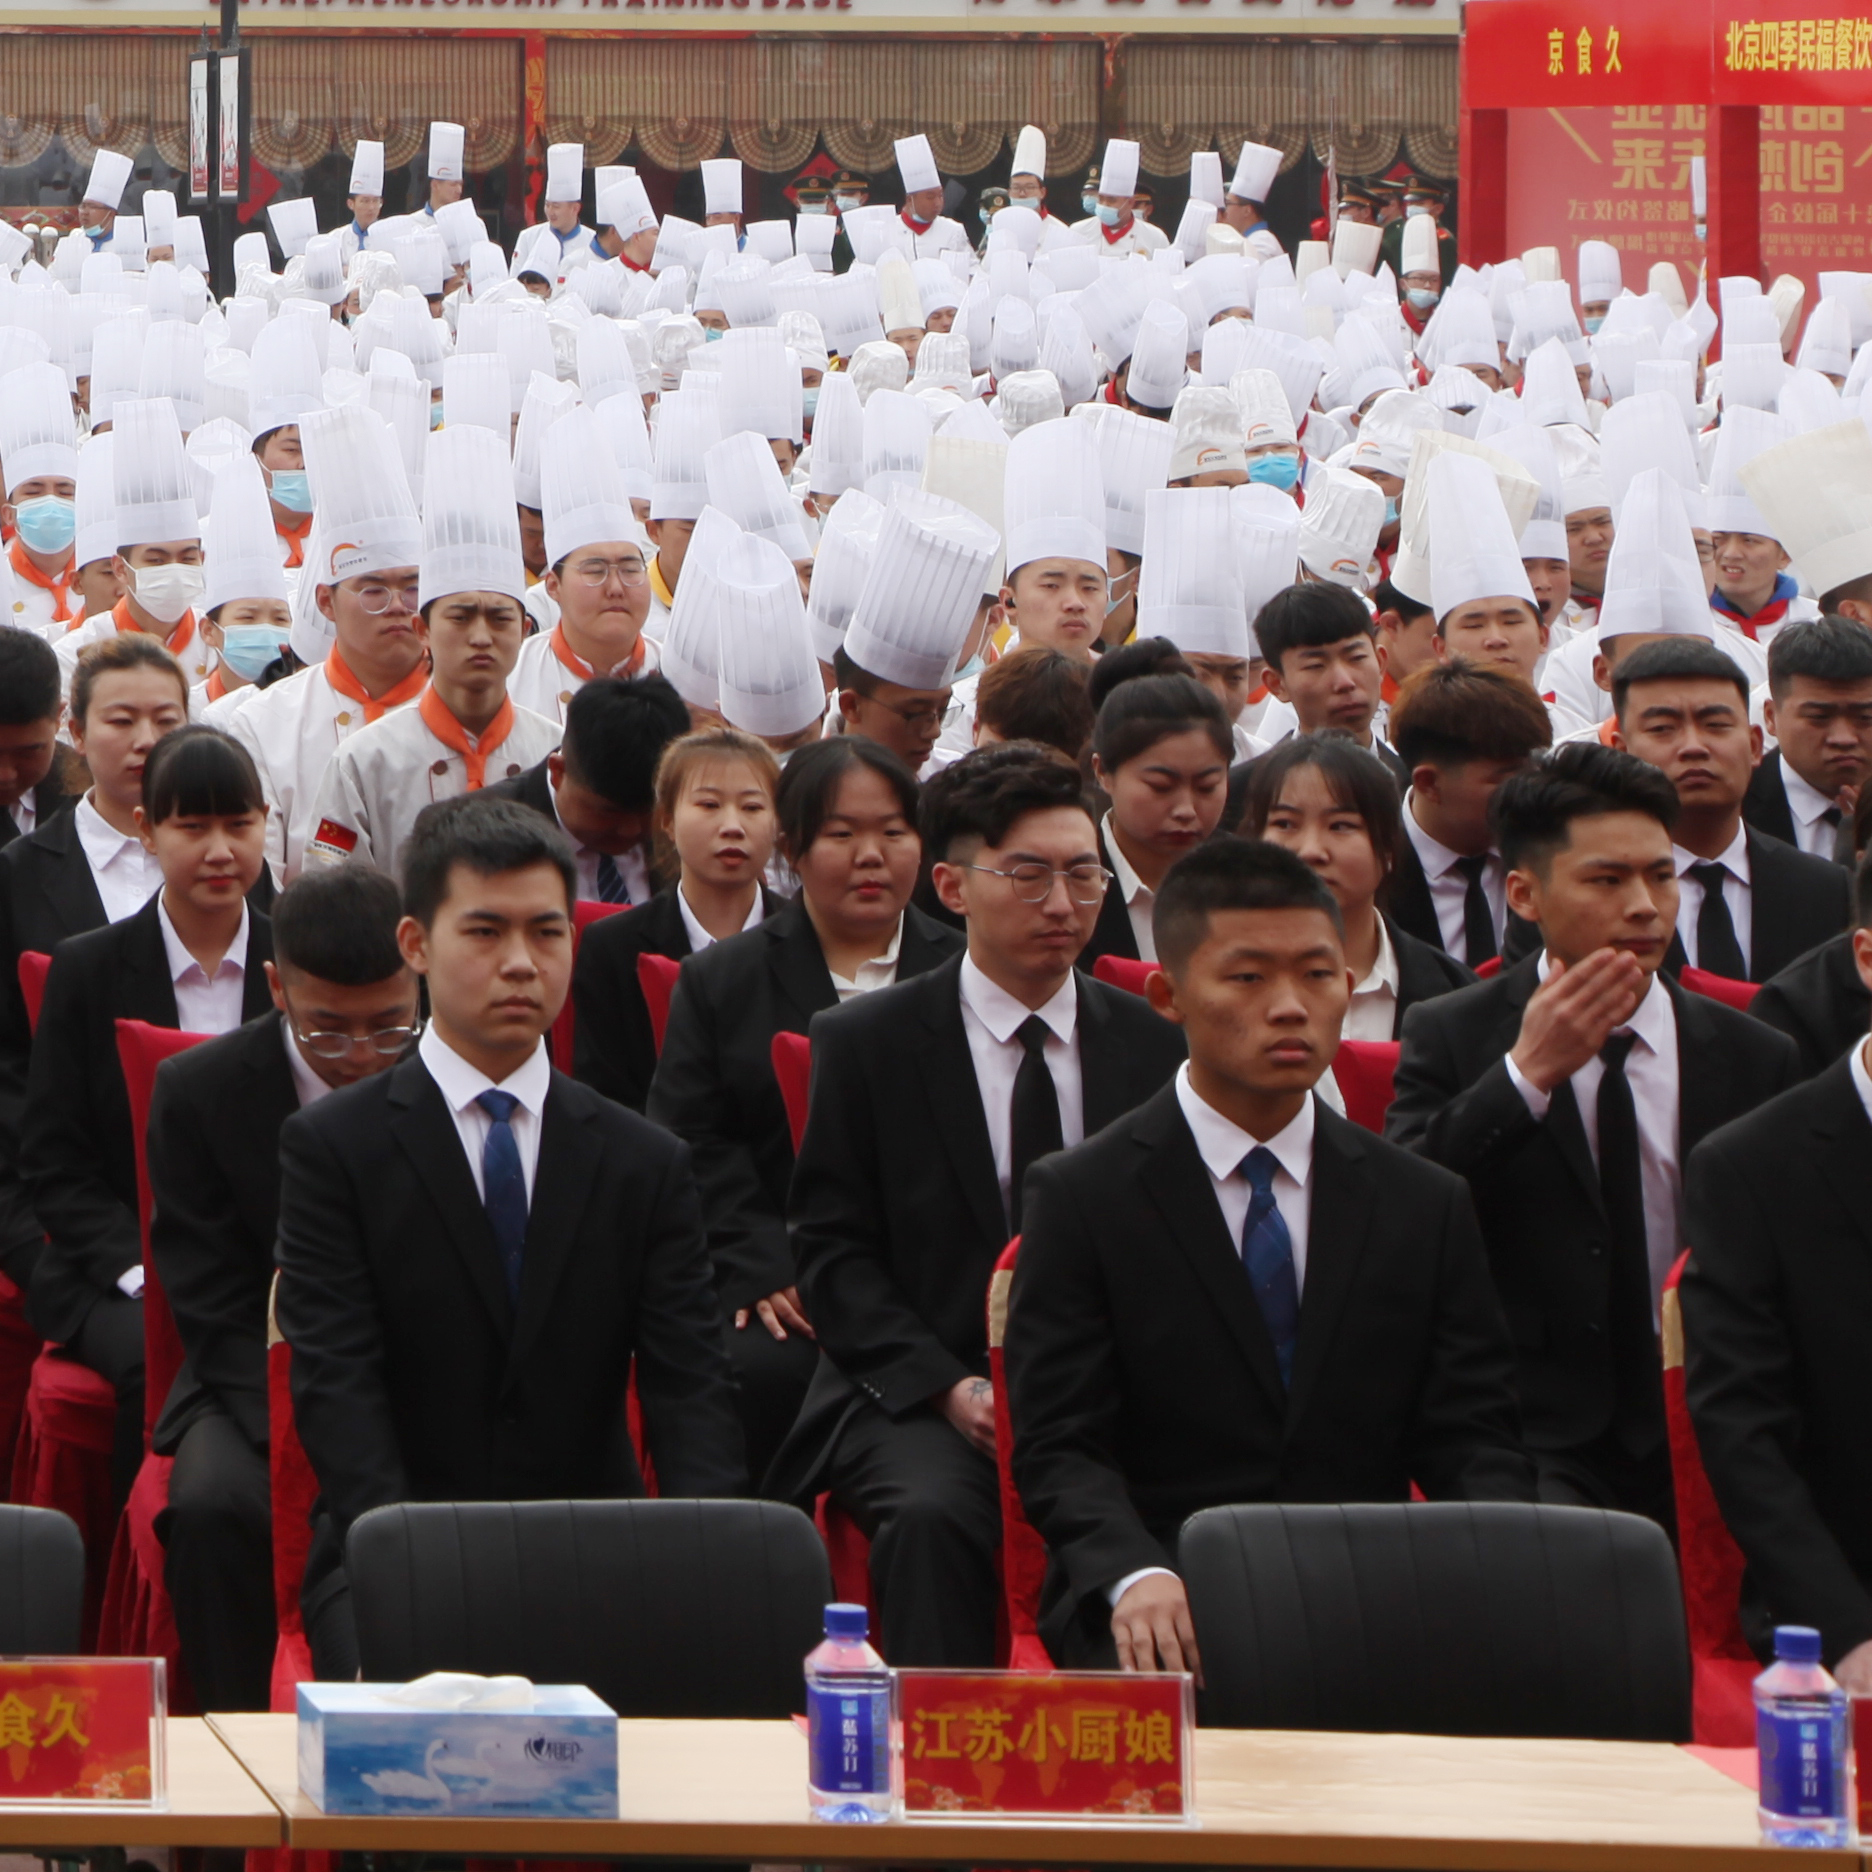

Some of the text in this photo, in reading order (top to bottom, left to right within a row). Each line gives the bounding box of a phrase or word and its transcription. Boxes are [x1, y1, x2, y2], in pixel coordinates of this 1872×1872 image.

[1547, 25, 1622, 76] 京食久
[1725, 17, 1872, 72] 北京四季民福餐饮
[911, 1708, 1175, 1766] 江苏小厨娘
